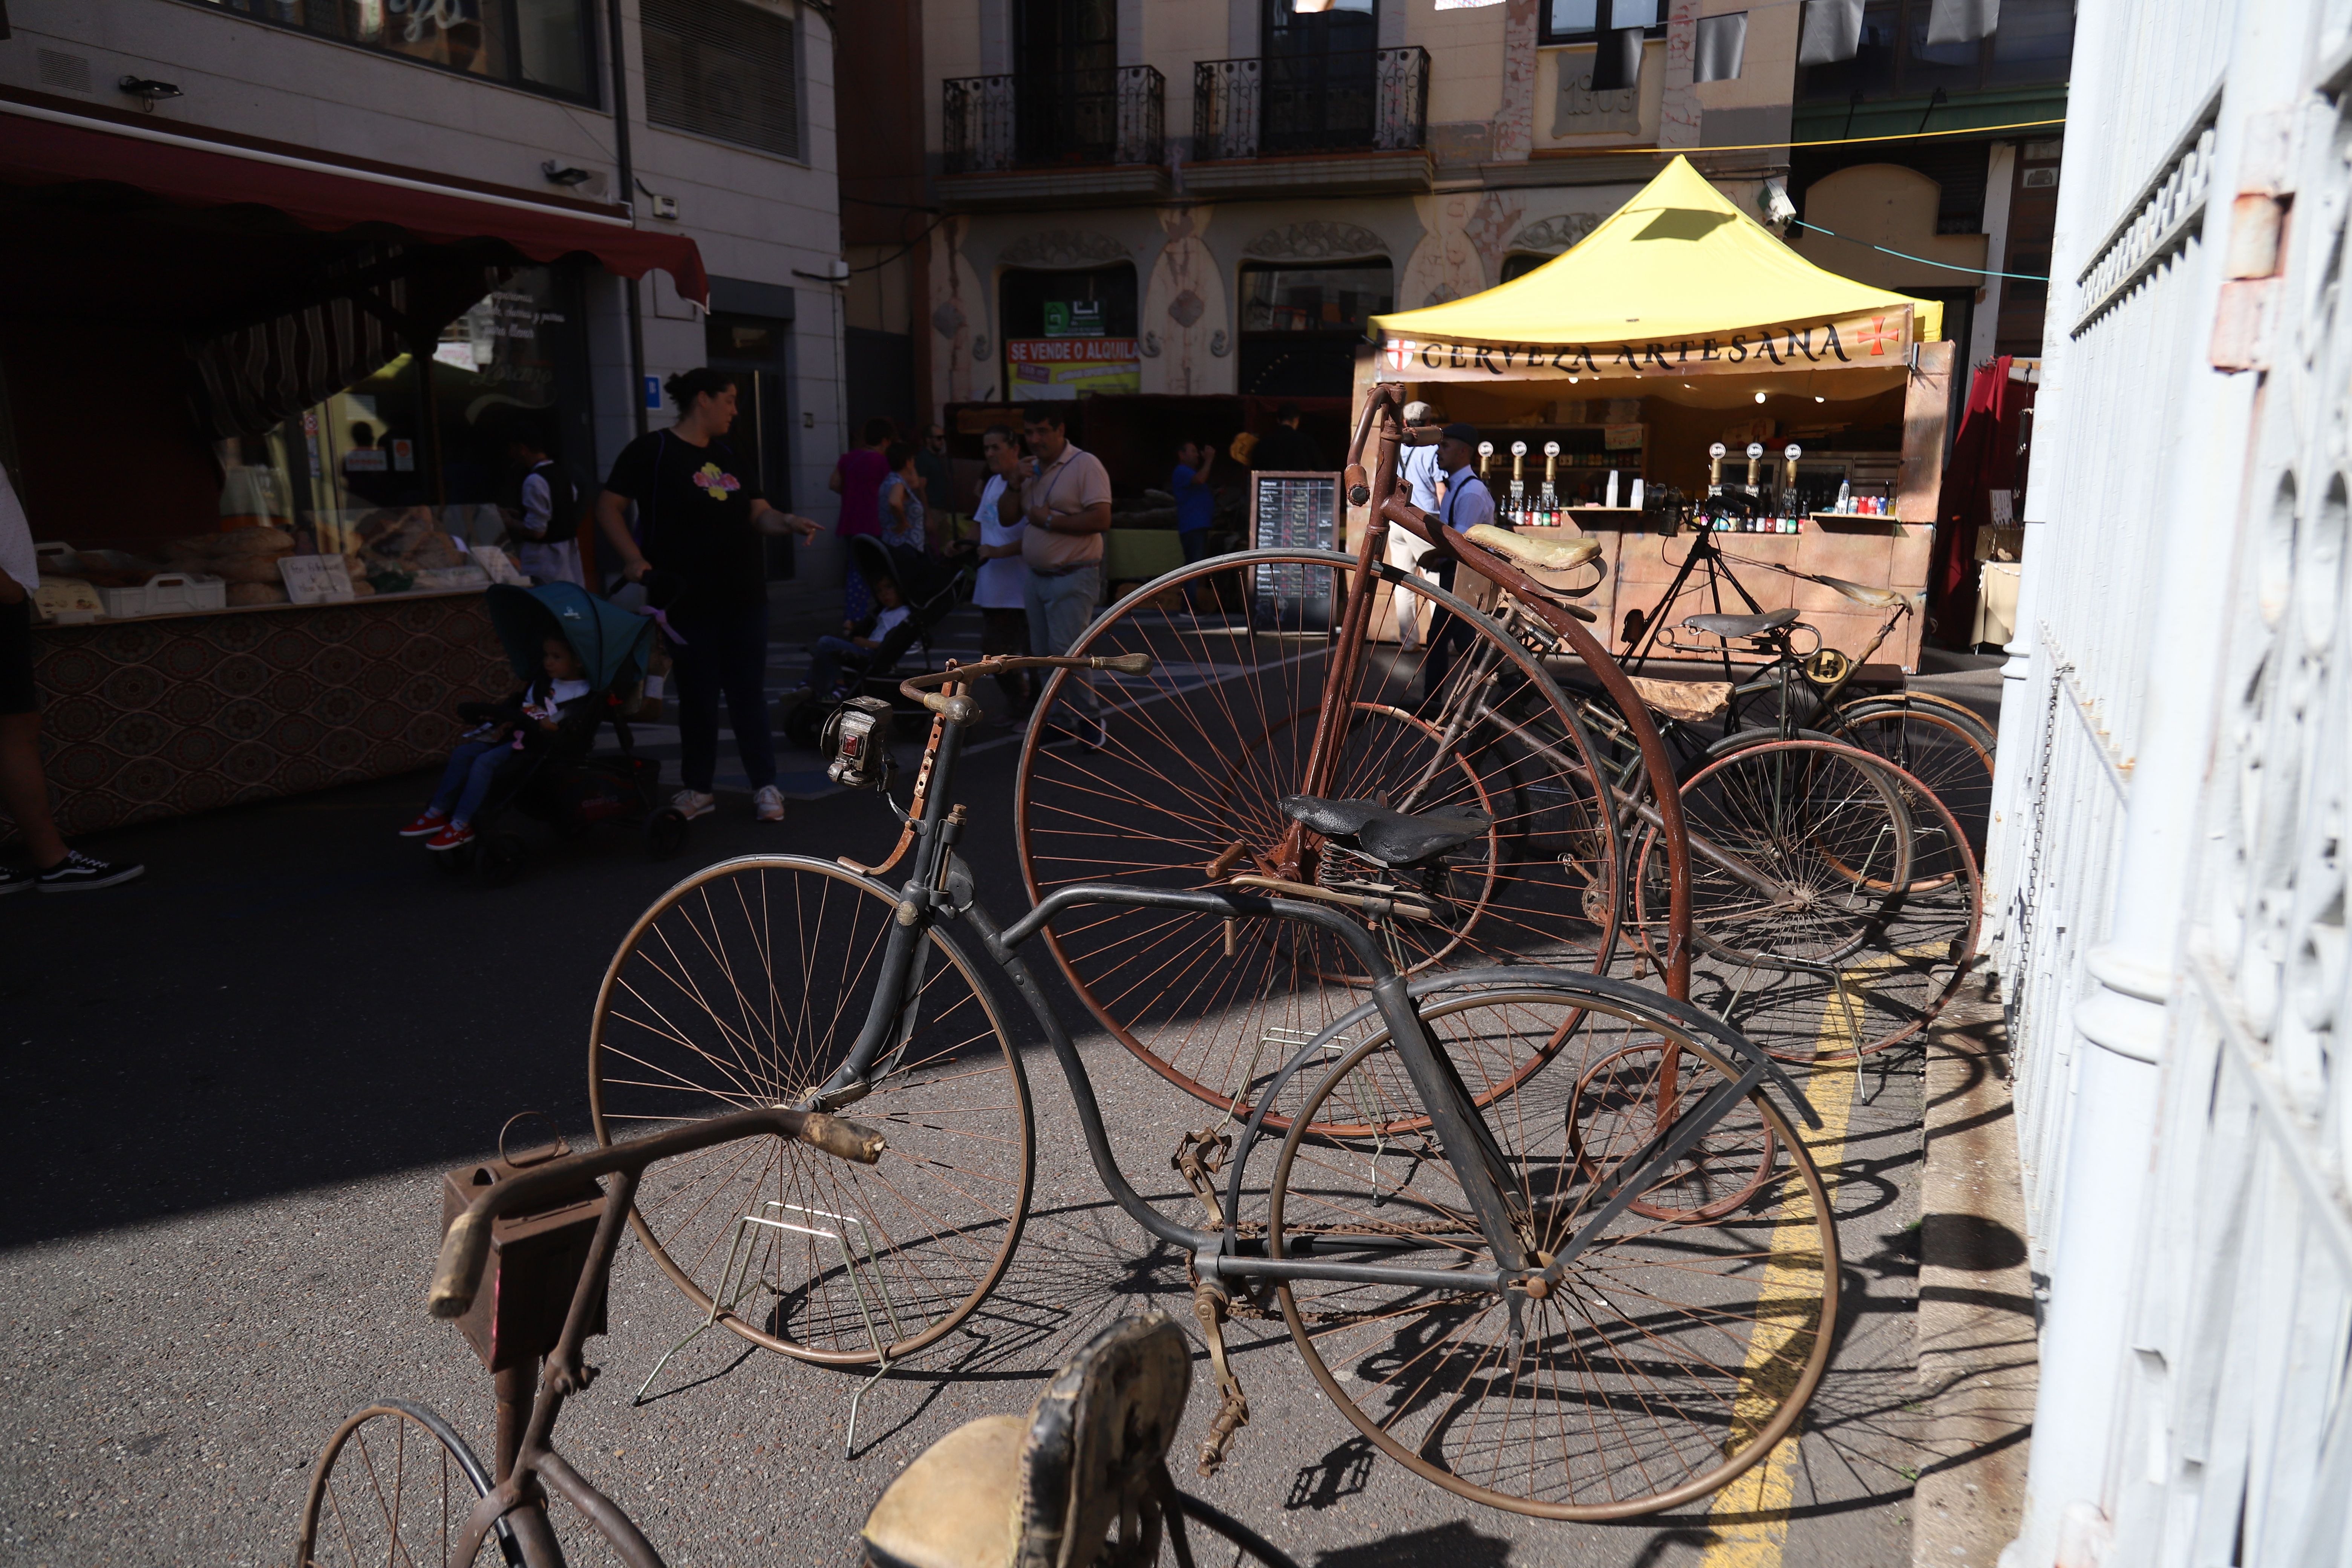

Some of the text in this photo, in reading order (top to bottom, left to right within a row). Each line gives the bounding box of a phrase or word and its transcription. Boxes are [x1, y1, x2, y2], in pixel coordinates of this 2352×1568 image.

[1011, 341, 1138, 360] SE VENDE O ALQUILA
[1422, 324, 1852, 374] CERVEZA ARTESANA
[1812, 657, 1839, 678] 15
